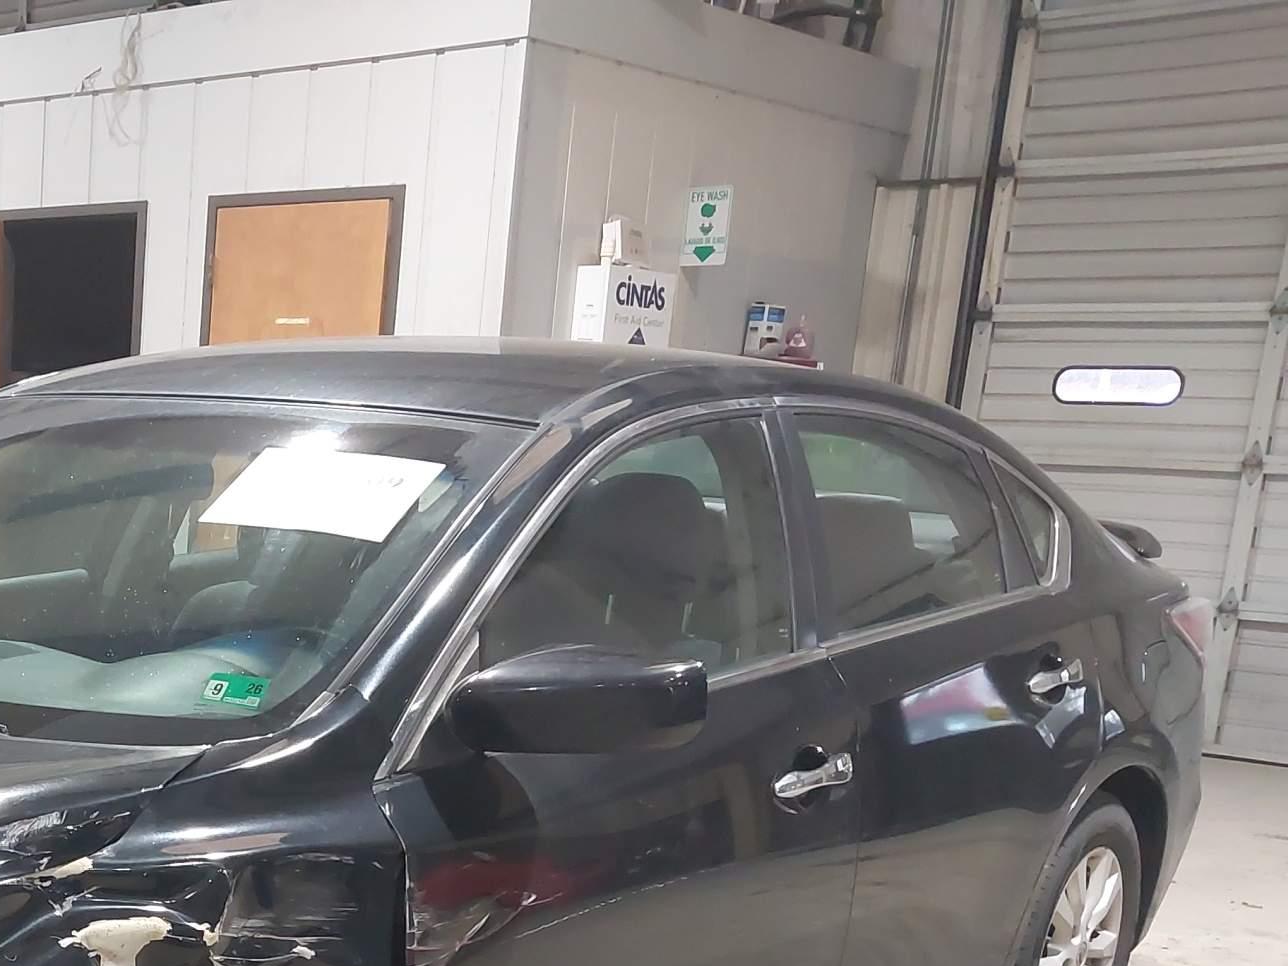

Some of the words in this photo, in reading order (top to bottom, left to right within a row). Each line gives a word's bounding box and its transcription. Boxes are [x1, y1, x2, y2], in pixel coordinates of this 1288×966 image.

[691, 191, 705, 203] EYE
[707, 189, 729, 201] WASH
[211, 683, 224, 696] 9
[246, 683, 264, 695] 26
